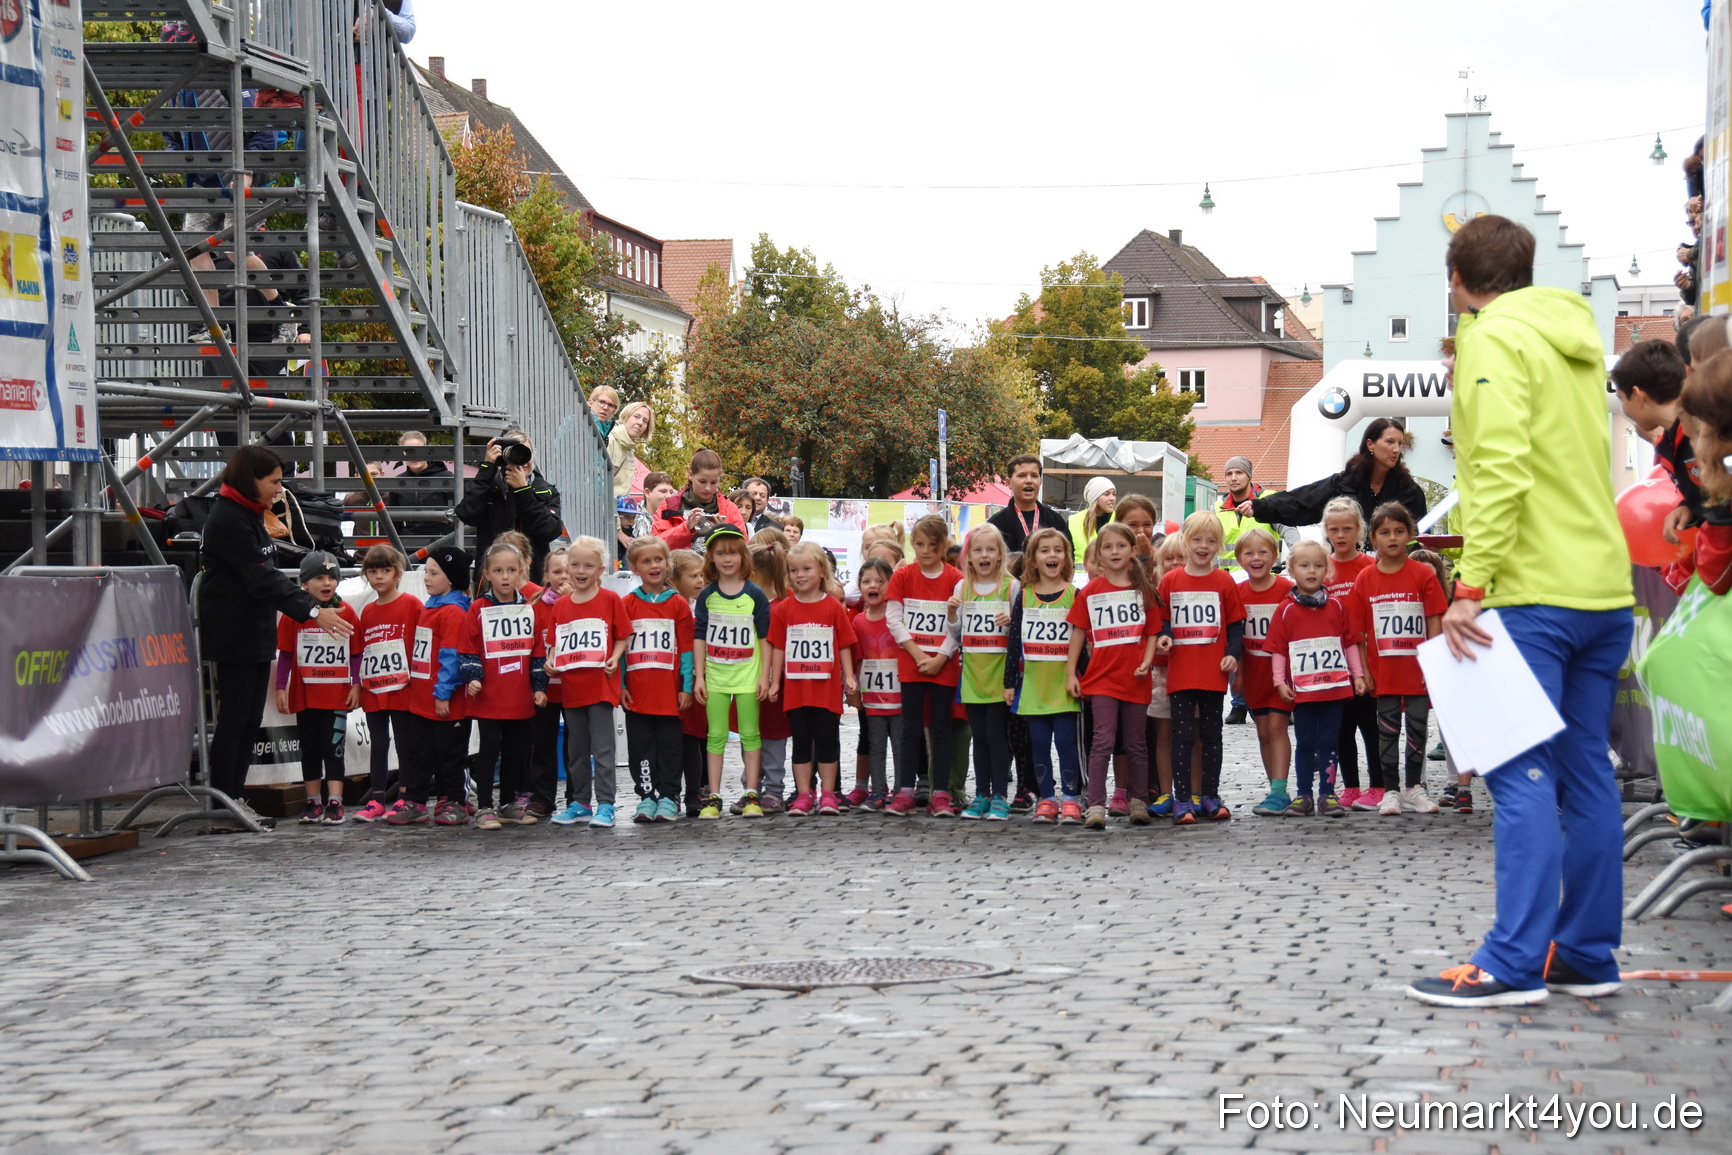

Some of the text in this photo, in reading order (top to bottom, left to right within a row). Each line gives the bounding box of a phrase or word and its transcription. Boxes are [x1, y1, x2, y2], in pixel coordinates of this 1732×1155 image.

[17, 279, 40, 295] KANN
[1363, 373, 1447, 397] BMW
[1369, 592, 1405, 602] Neumarkter
[908, 611, 946, 632] 7237
[1094, 603, 1140, 626] 7168
[1173, 604, 1216, 624] 7109
[489, 617, 532, 638] 7013
[1027, 621, 1069, 641] 7232
[1107, 629, 1129, 638] Helga
[1182, 629, 1203, 637] Laura
[1380, 615, 1423, 635] 7040
[560, 631, 602, 652] 7045
[628, 631, 671, 651] 7118
[710, 624, 750, 646] 7410
[914, 635, 935, 645] Anouk
[971, 637, 999, 646] Marlene
[1392, 639, 1413, 648] Marie
[303, 645, 346, 664] 7254
[500, 641, 525, 650] Sophia
[713, 647, 745, 661] Kajsa
[791, 640, 830, 659] 7031
[15, 650, 70, 686] OFFICE
[138, 632, 190, 667] LOUNGE
[363, 652, 403, 676] 7249
[569, 653, 587, 662] Frida
[1296, 649, 1343, 672] 7122
[311, 668, 336, 678] Sophia
[800, 663, 821, 672] Paula
[864, 671, 898, 690] 741
[43, 685, 181, 736] www.bockonline.de
